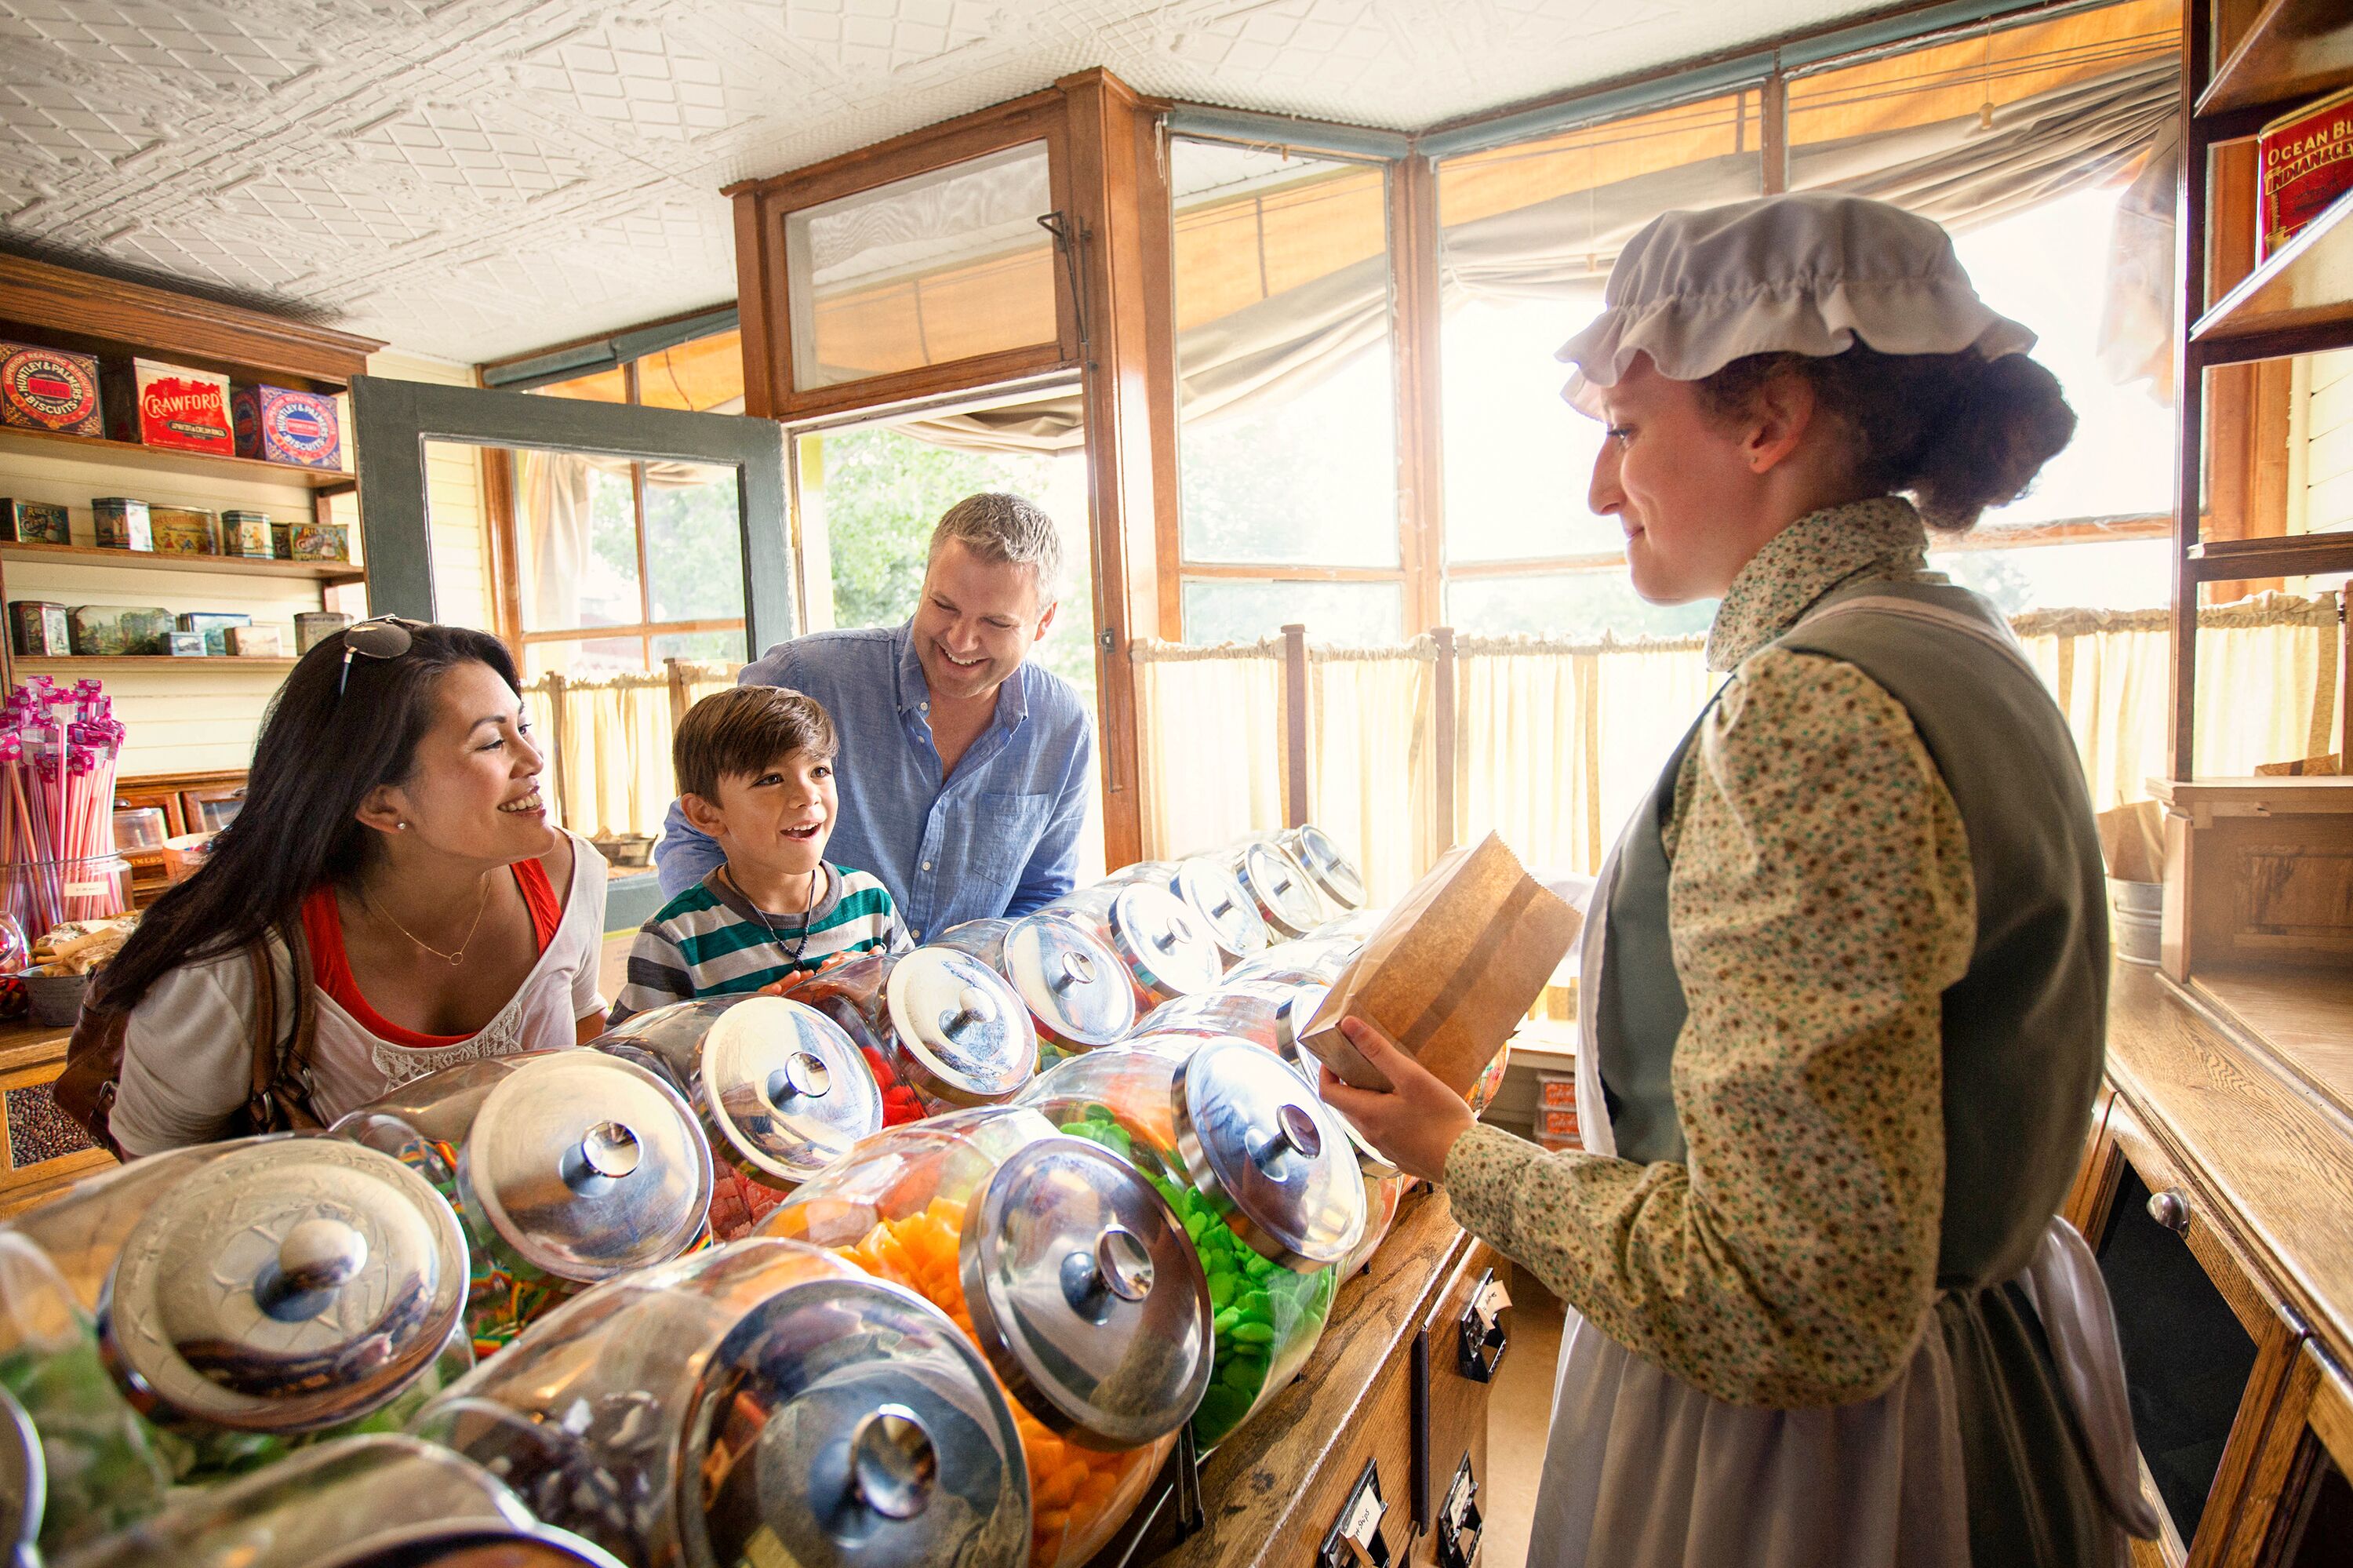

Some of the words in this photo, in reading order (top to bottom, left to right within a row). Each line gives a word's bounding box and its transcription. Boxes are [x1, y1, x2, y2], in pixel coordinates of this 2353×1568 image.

[2268, 129, 2328, 166] OCEAN
[5, 355, 26, 385] SUPERIOR
[27, 351, 67, 366] READING
[16, 361, 42, 392] HUNTLEY
[42, 362, 51, 371] &
[51, 363, 83, 401] PALMERS
[24, 395, 79, 416] BISCUITS
[276, 404, 297, 431] HUNTLEY
[304, 405, 329, 438] PALMERS
[283, 434, 325, 452] BISCUITS
